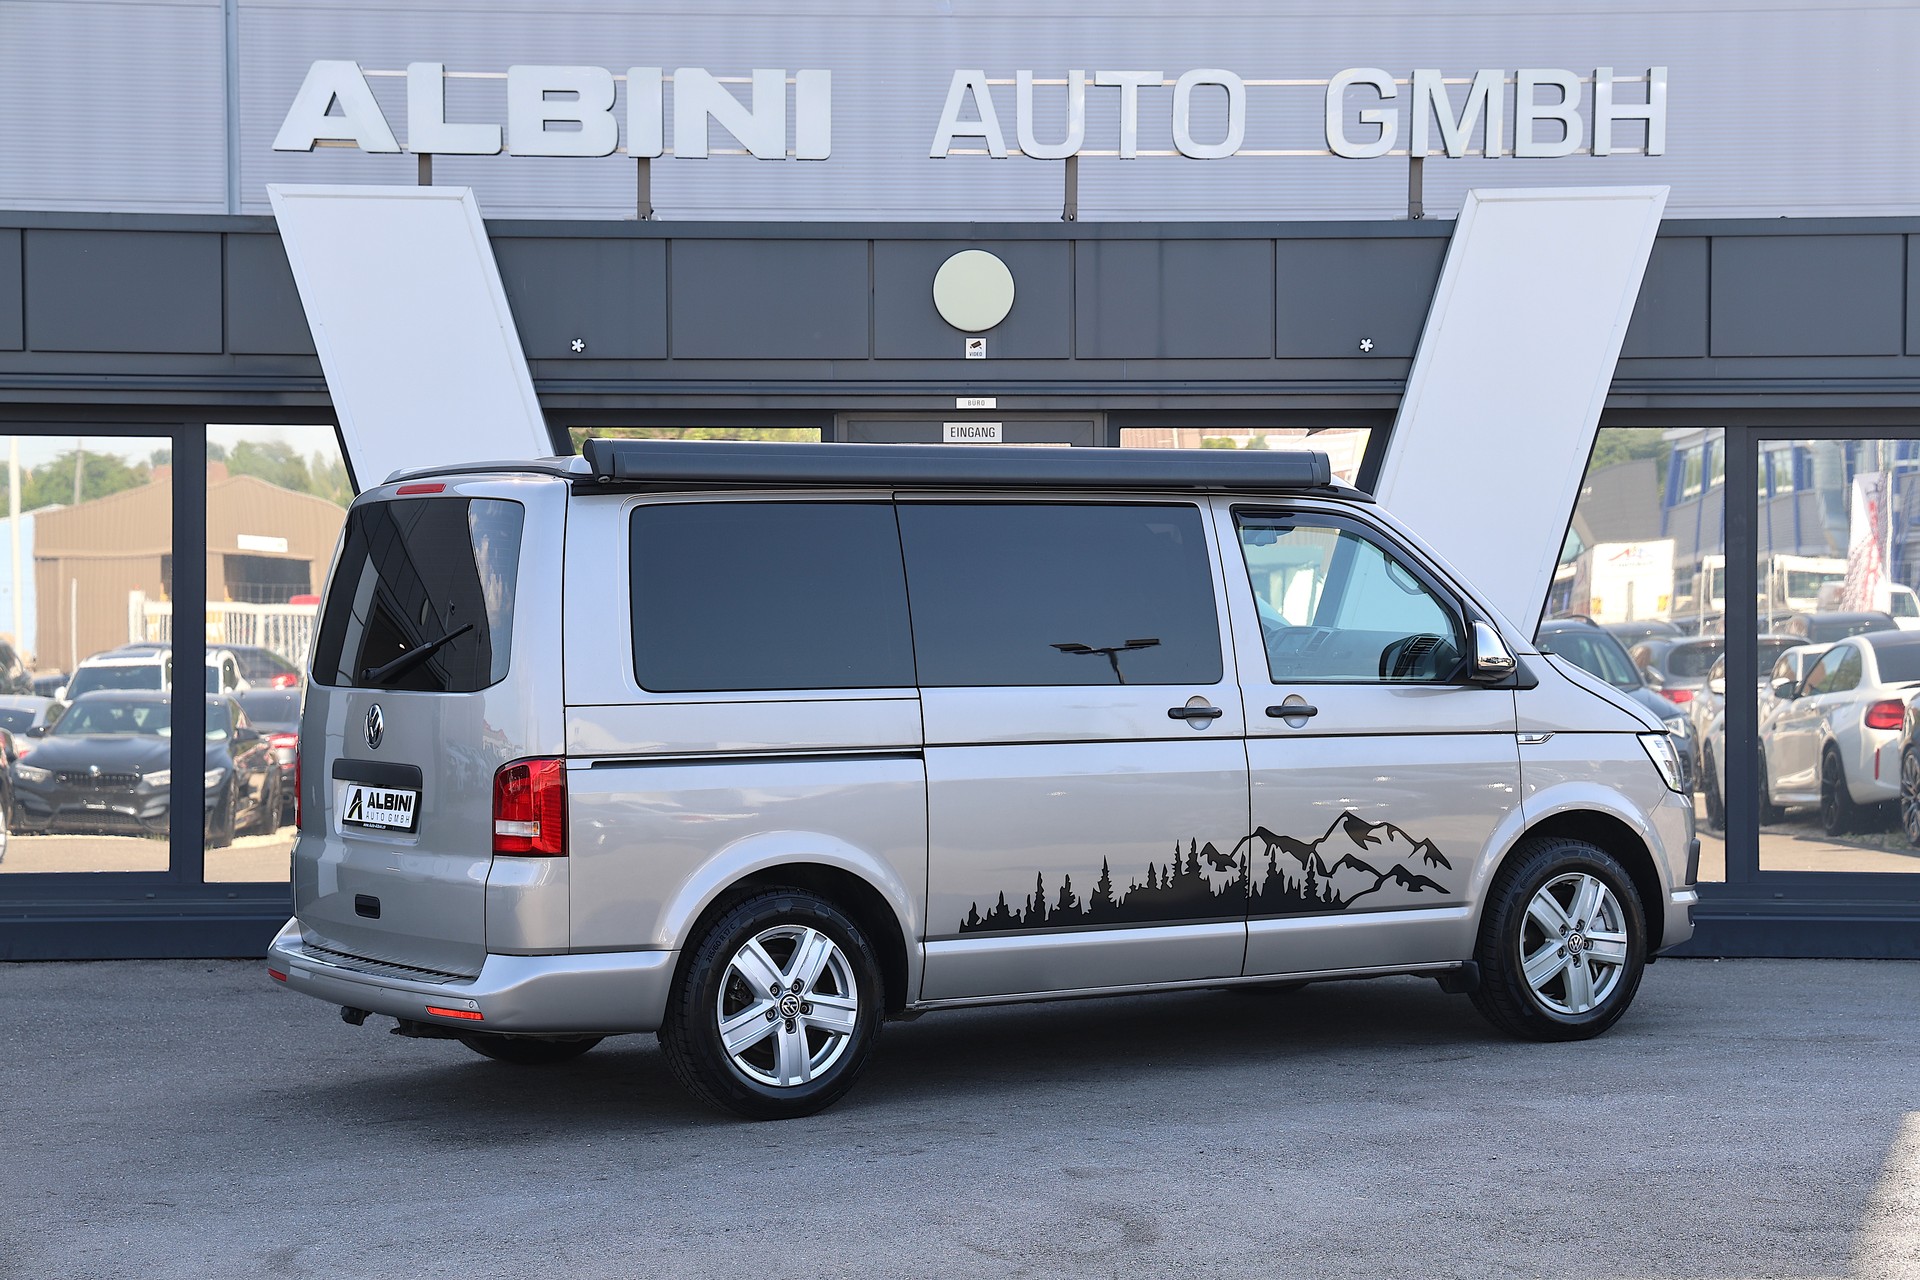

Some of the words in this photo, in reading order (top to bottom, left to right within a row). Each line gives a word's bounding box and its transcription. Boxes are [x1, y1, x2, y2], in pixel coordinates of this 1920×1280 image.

[271, 59, 832, 161] ALBINI
[929, 68, 1247, 160] AUTO
[1324, 66, 1669, 160] GMBH
[950, 427, 996, 438] EINGANG
[367, 792, 412, 812] ALBINI
[365, 811, 384, 821] AUTO
[387, 813, 411, 823] GMBH
[706, 940, 722, 963] 215/60
[723, 927, 731, 936] 17
